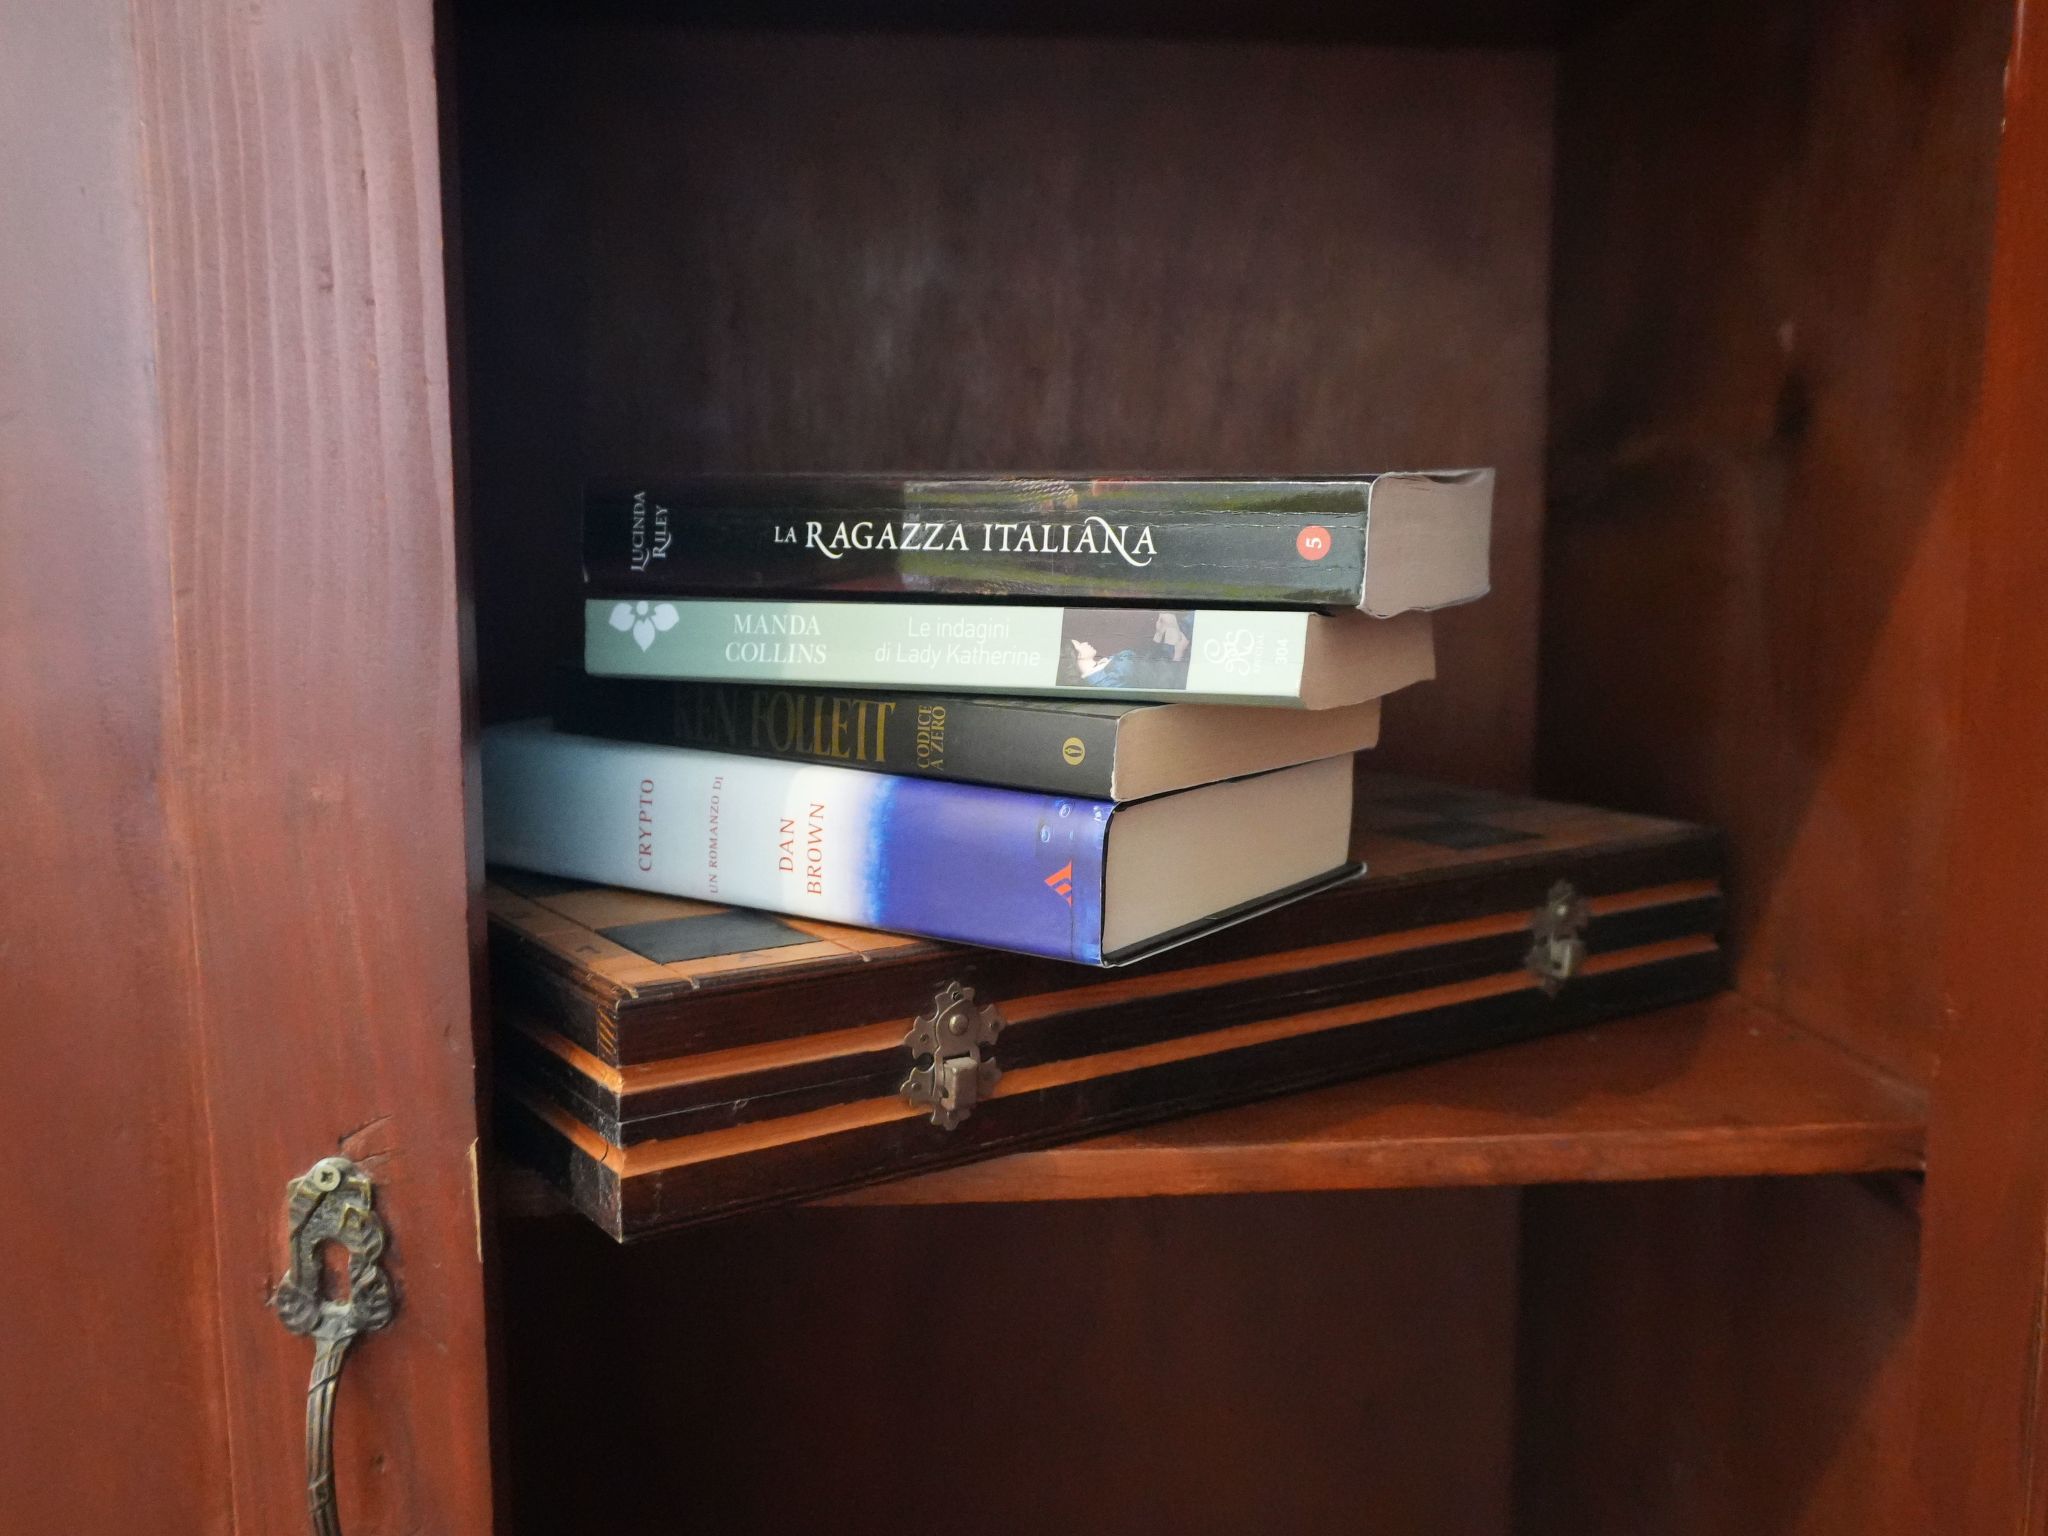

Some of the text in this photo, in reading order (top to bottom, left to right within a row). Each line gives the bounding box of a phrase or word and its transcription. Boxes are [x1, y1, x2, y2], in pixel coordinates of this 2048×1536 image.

[631, 492, 650, 572] LUCINDA
[652, 505, 672, 559] RILEY
[774, 516, 1157, 567] LA RAGAZZA ITALIANA
[725, 641, 827, 664] COLLINS
[733, 614, 822, 636] MANDA
[907, 616, 1010, 644] Le indagini
[1274, 638, 1289, 664] 304
[875, 642, 1041, 668] di Lady Katherine
[672, 684, 897, 763] KEN FOLLETT
[917, 705, 931, 768] CODICE
[930, 706, 946, 772] A ZERO
[638, 779, 655, 872] CRYPTO
[708, 776, 724, 894] UN ROMANZO DI
[778, 818, 796, 873] DAN
[806, 803, 825, 896] BROWN
